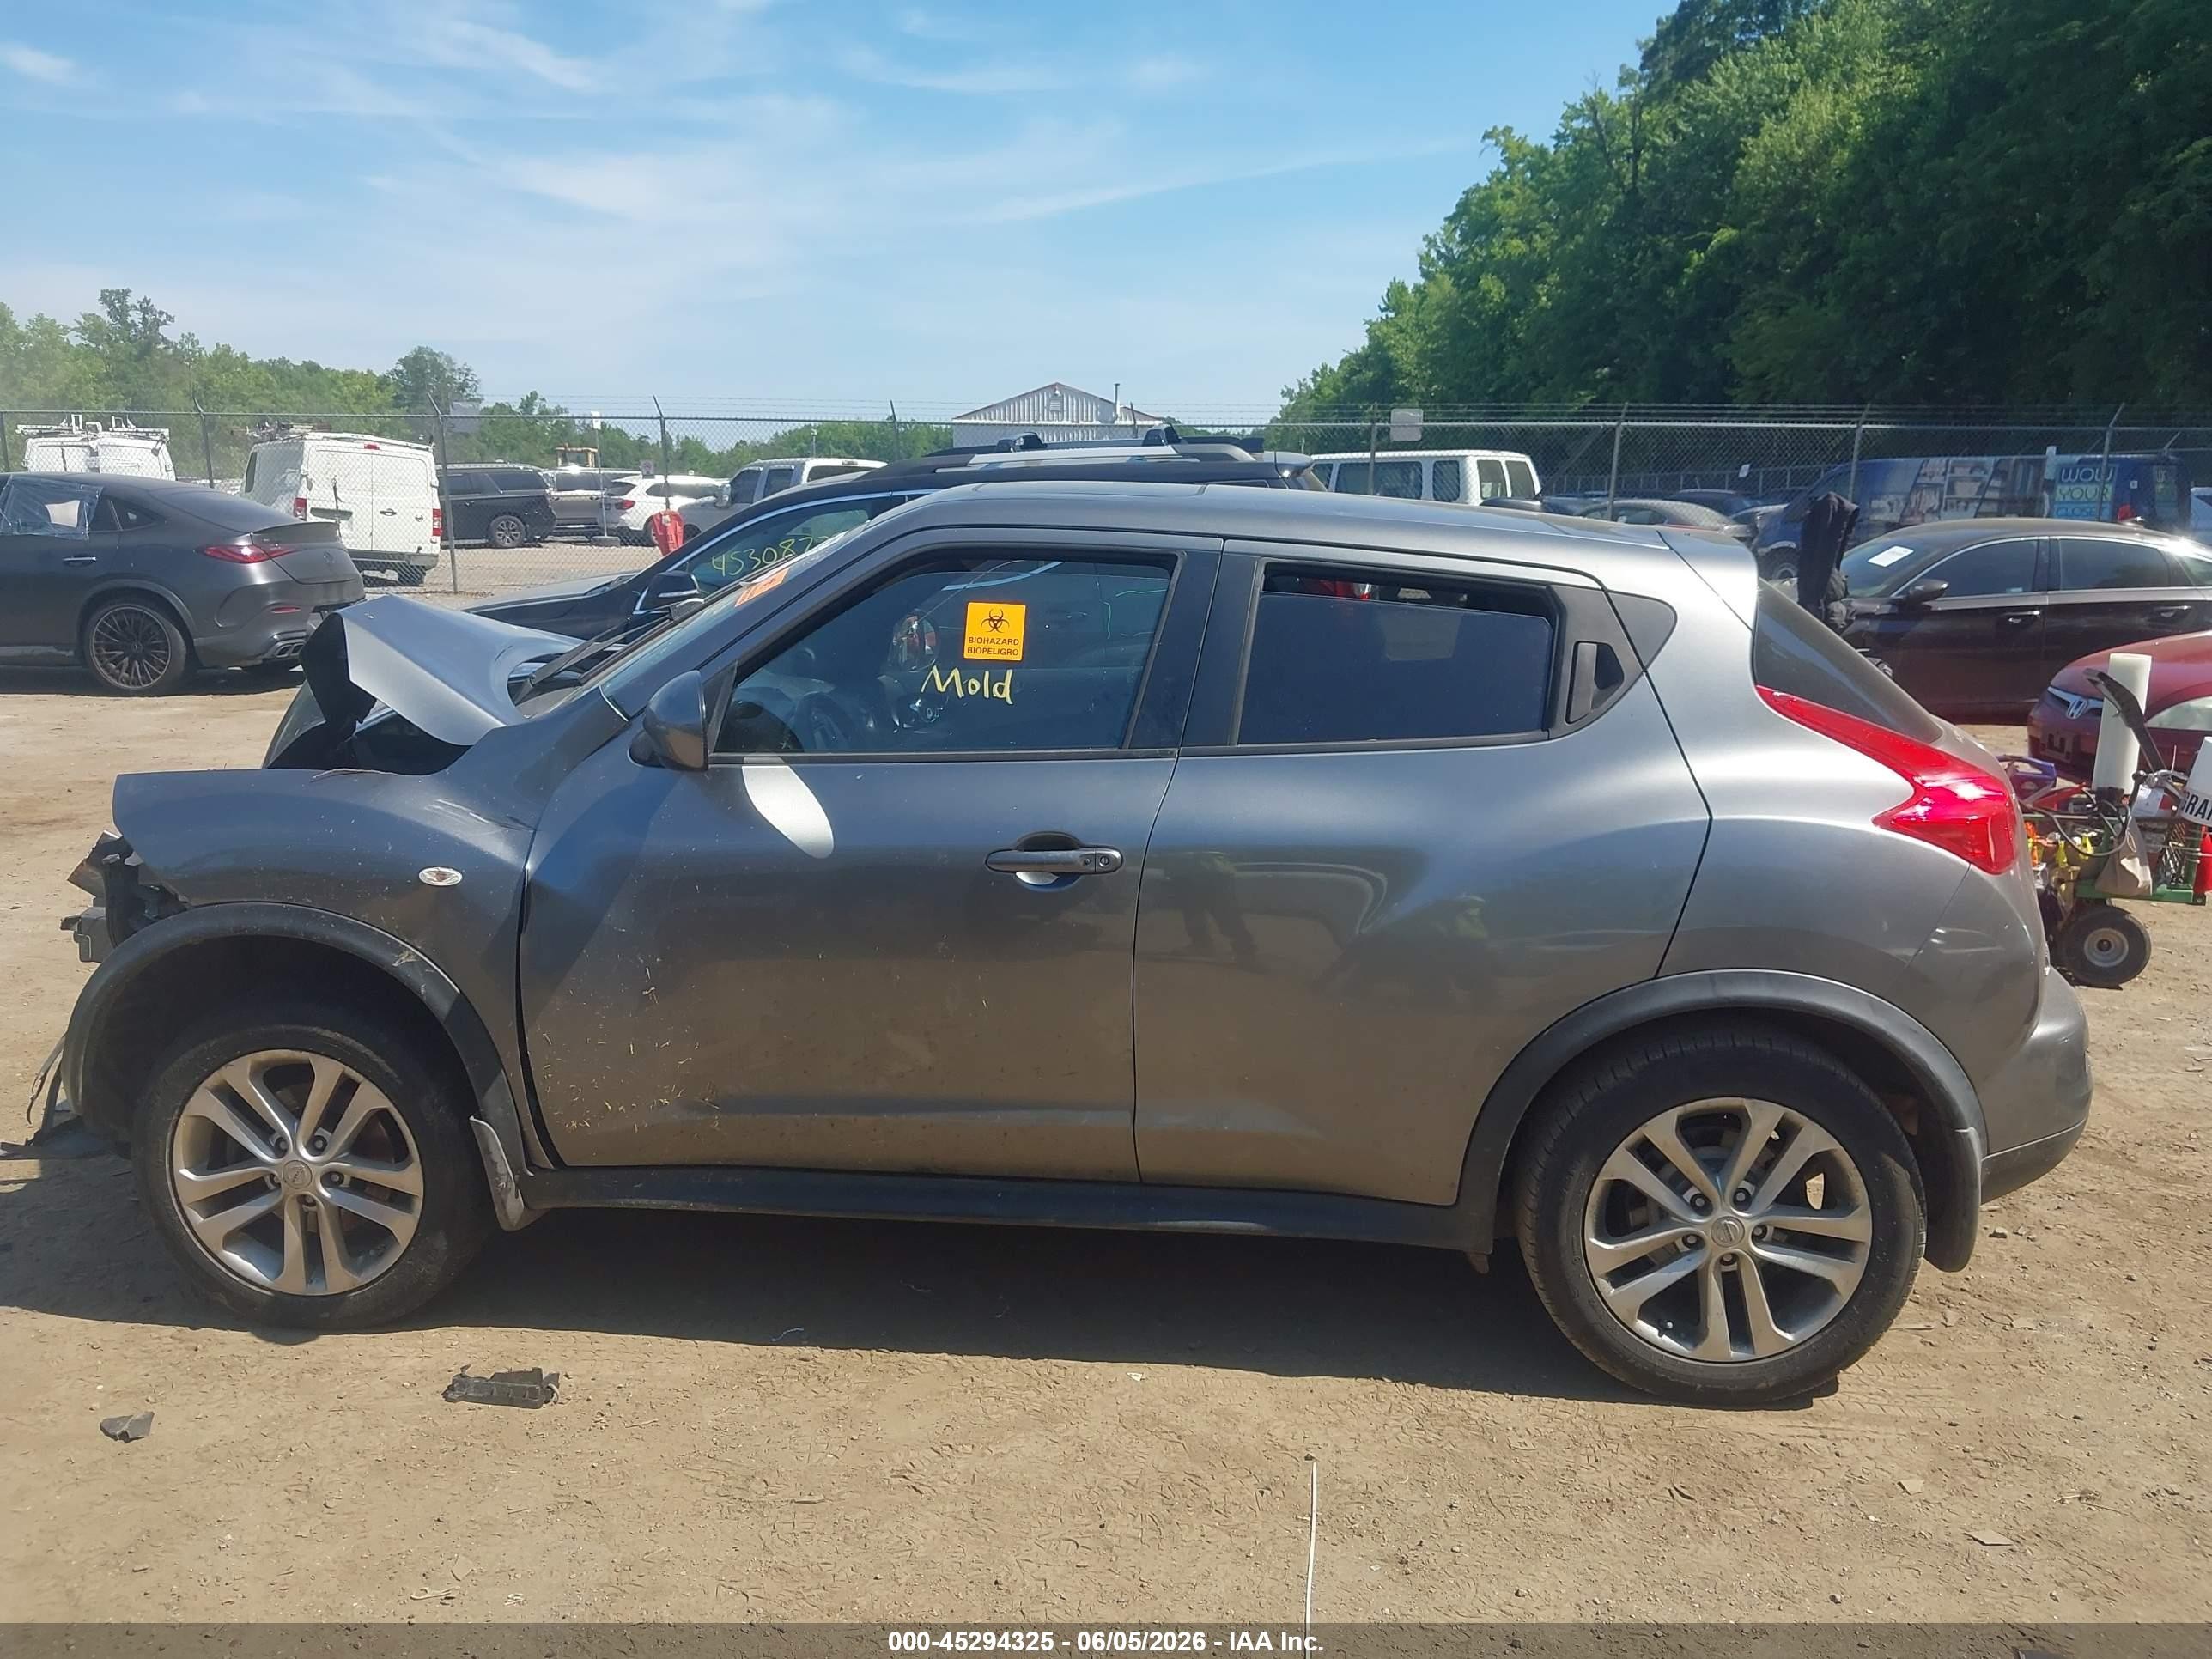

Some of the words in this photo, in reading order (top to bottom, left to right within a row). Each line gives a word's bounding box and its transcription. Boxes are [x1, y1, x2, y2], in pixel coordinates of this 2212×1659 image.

[2061, 466, 2114, 483] WOW
[2059, 486, 2109, 501] YOUR
[2056, 507, 2104, 518] CLOSE
[968, 636, 1019, 646] BIOHAZARD
[967, 647, 1019, 656] BIOPELIGRO
[921, 665, 1013, 705] Mold
[2180, 790, 2212, 821] RA
